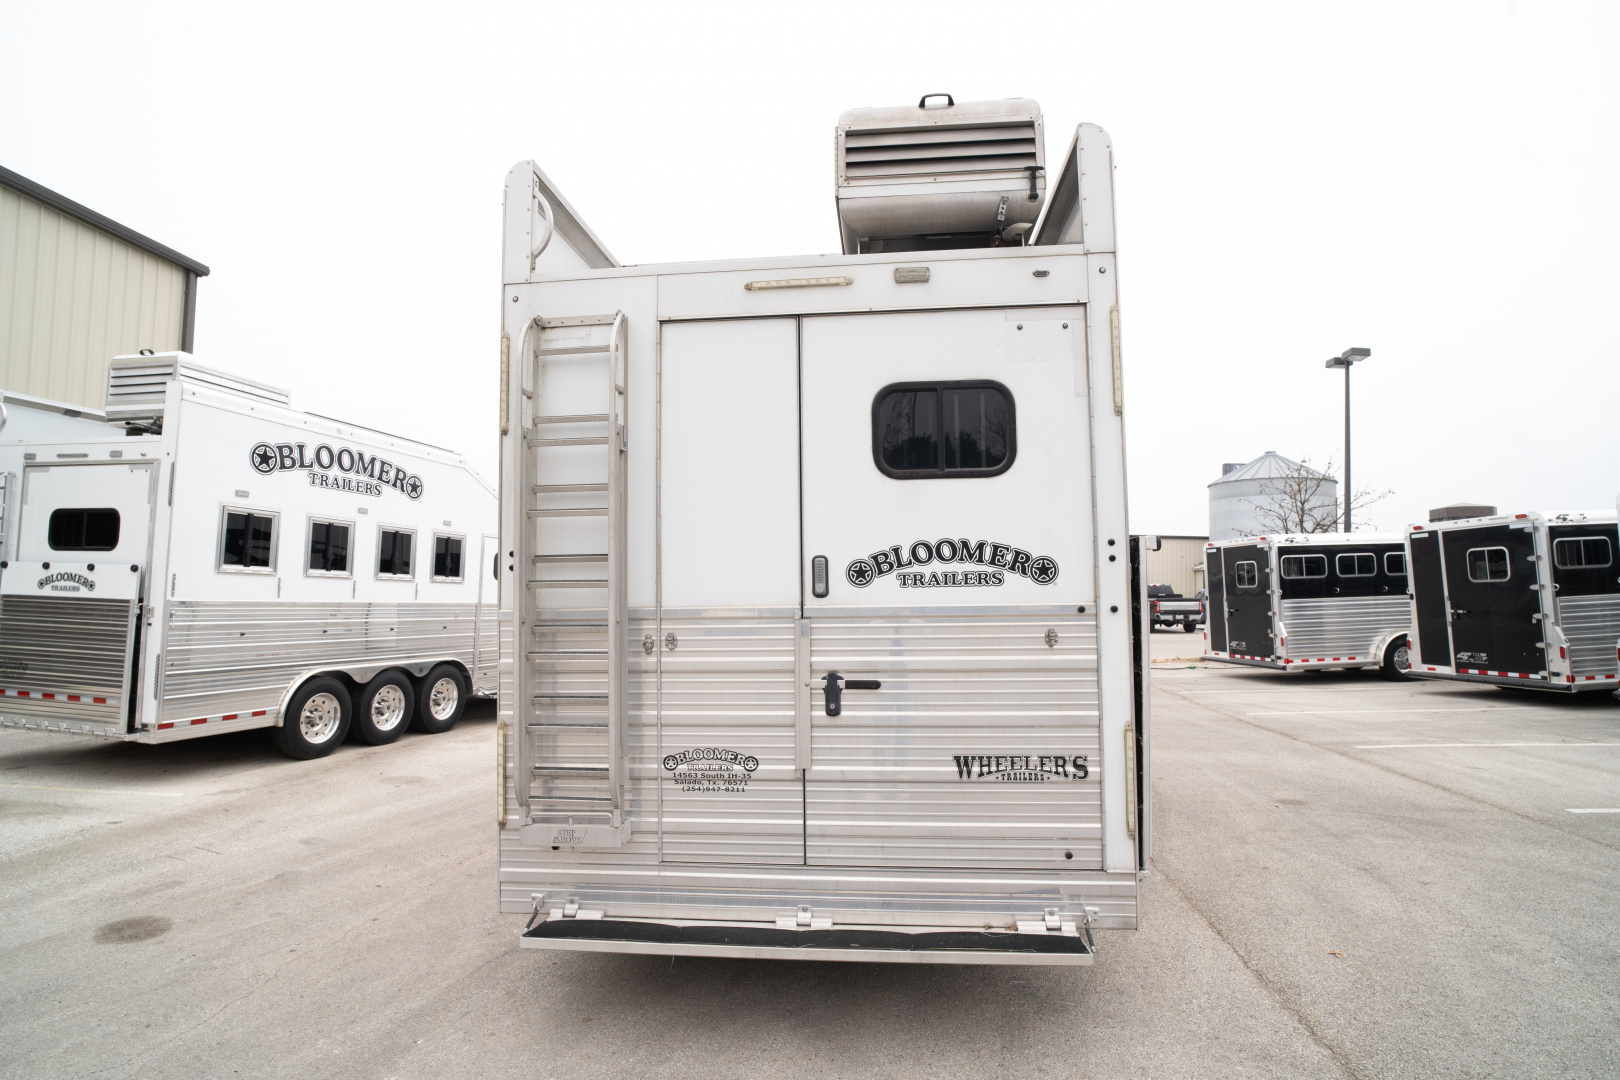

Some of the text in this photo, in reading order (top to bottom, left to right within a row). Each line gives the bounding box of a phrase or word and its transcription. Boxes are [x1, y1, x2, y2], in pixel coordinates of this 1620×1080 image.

[275, 443, 408, 494] BLOOMER
[307, 470, 383, 497] TRAILERS
[868, 538, 1034, 577] BLOOMER
[44, 572, 90, 588] BLOOMER
[896, 570, 1005, 588] TRAILERS
[674, 748, 747, 768] BLOOMER
[952, 754, 1090, 780] WHEELER'S
[686, 764, 734, 772] TRAILERS
[1000, 772, 1045, 781] TRAILERS
[557, 829, 575, 837] STEP
